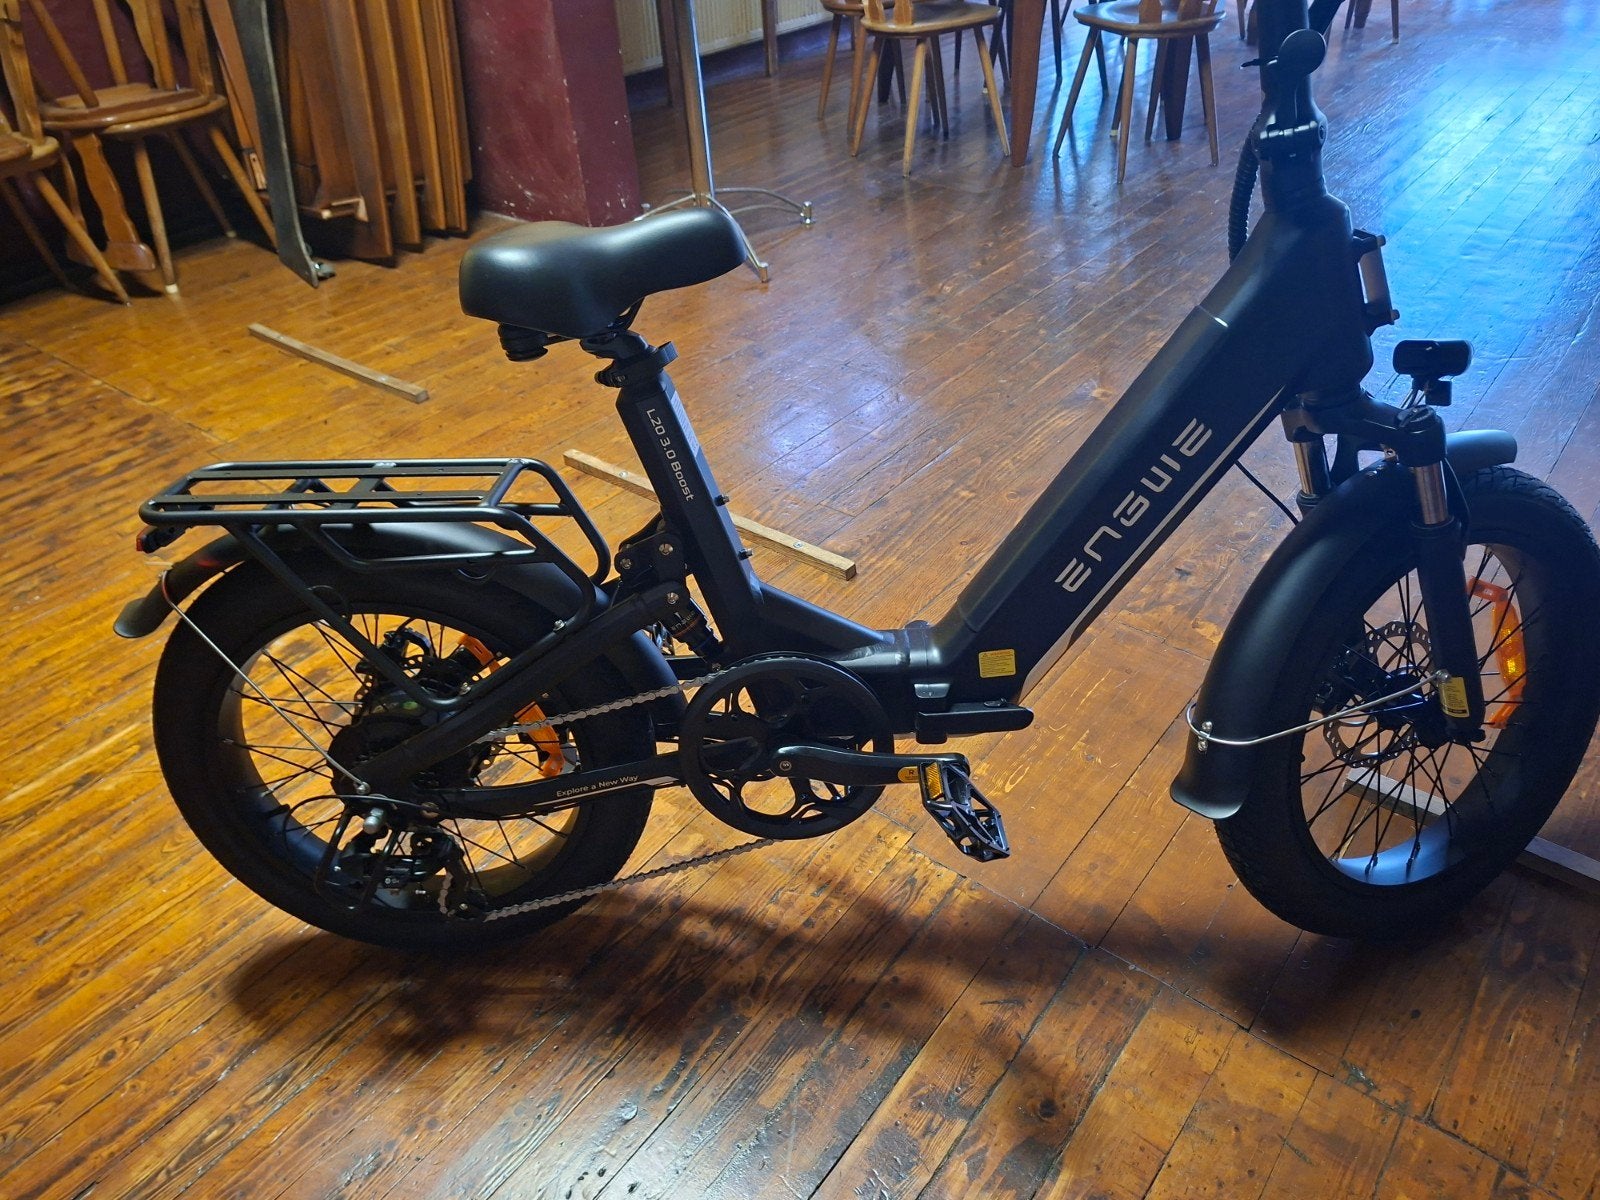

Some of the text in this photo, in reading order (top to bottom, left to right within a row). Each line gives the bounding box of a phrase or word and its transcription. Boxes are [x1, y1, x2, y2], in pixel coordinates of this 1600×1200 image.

[646, 408, 666, 435] L20
[660, 437, 677, 460] 3.0
[671, 461, 695, 502] Boost
[1054, 417, 1213, 592] ENGWE
[556, 786, 589, 797] Explore
[598, 779, 619, 789] New
[620, 775, 639, 784] Way
